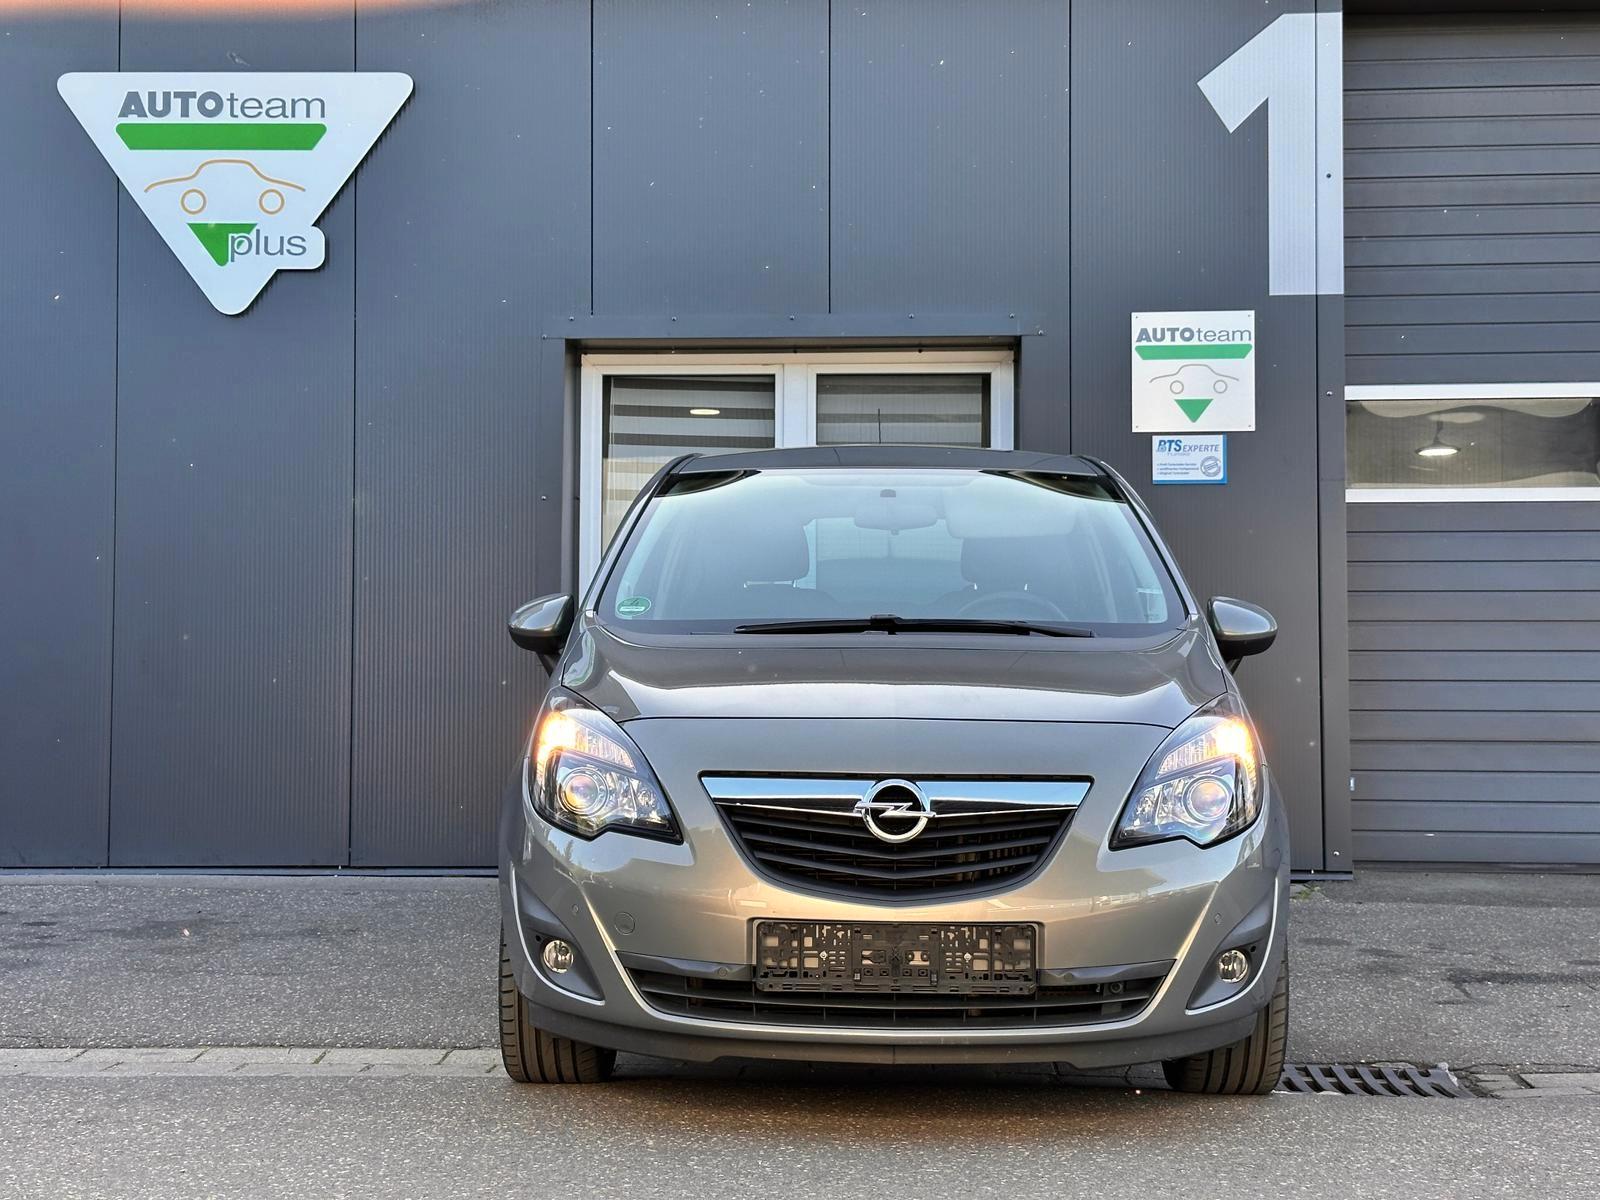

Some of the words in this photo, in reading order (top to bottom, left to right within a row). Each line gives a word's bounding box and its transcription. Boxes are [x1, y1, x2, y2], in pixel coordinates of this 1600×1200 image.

[117, 91, 326, 118] AUTOteam
[1197, 12, 1344, 296] 1
[230, 229, 307, 263] plus
[1136, 327, 1252, 343] AUTOteam
[1157, 439, 1182, 452] BTS
[1183, 444, 1219, 453] EXPERTE
